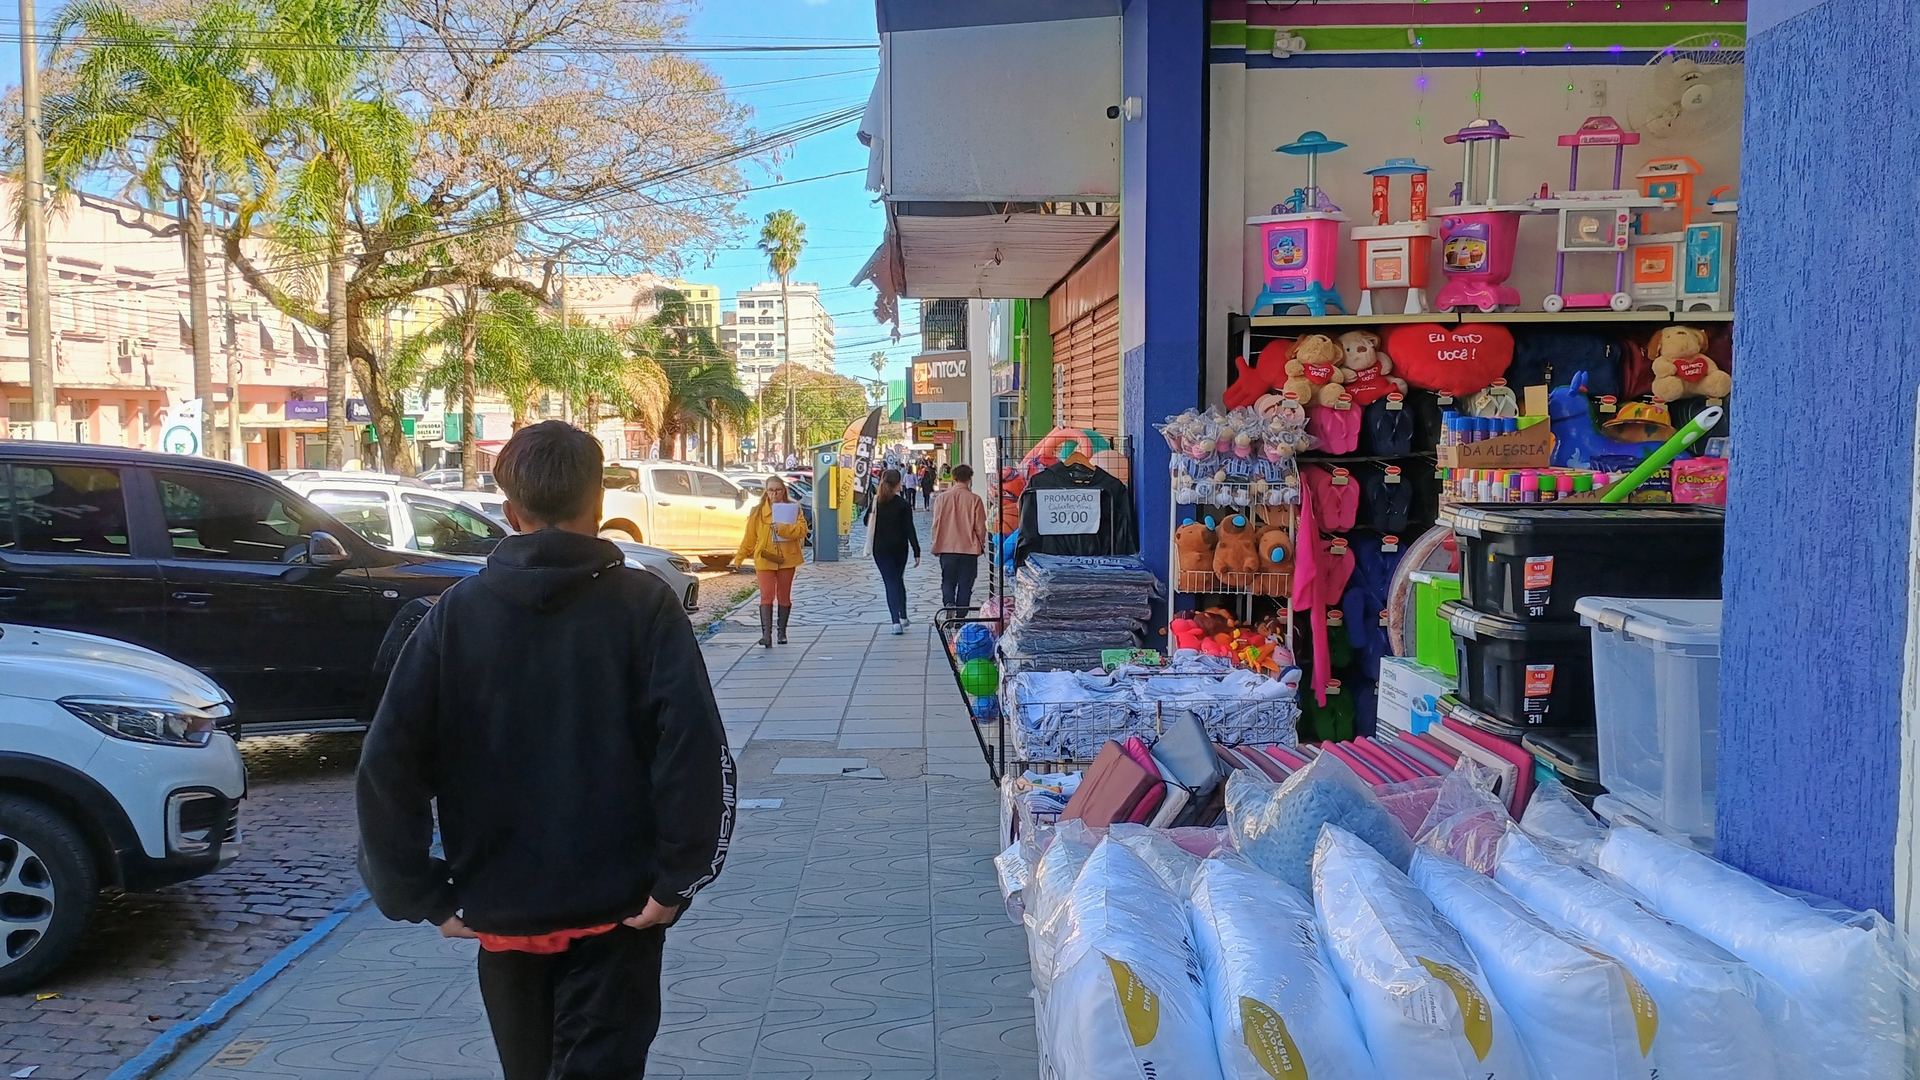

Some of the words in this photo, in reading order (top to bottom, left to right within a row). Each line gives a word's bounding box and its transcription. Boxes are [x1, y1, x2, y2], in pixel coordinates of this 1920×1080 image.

[1462, 445, 1481, 457] DA
[1486, 444, 1545, 456] ALEGRIA
[1044, 493, 1094, 503] PROMOÇÃO
[1050, 511, 1088, 526] 30,00
[1248, 1015, 1269, 1048] PRODUTO
[1262, 1021, 1279, 1055] NOVA
[1266, 1049, 1280, 1074] MESMO
